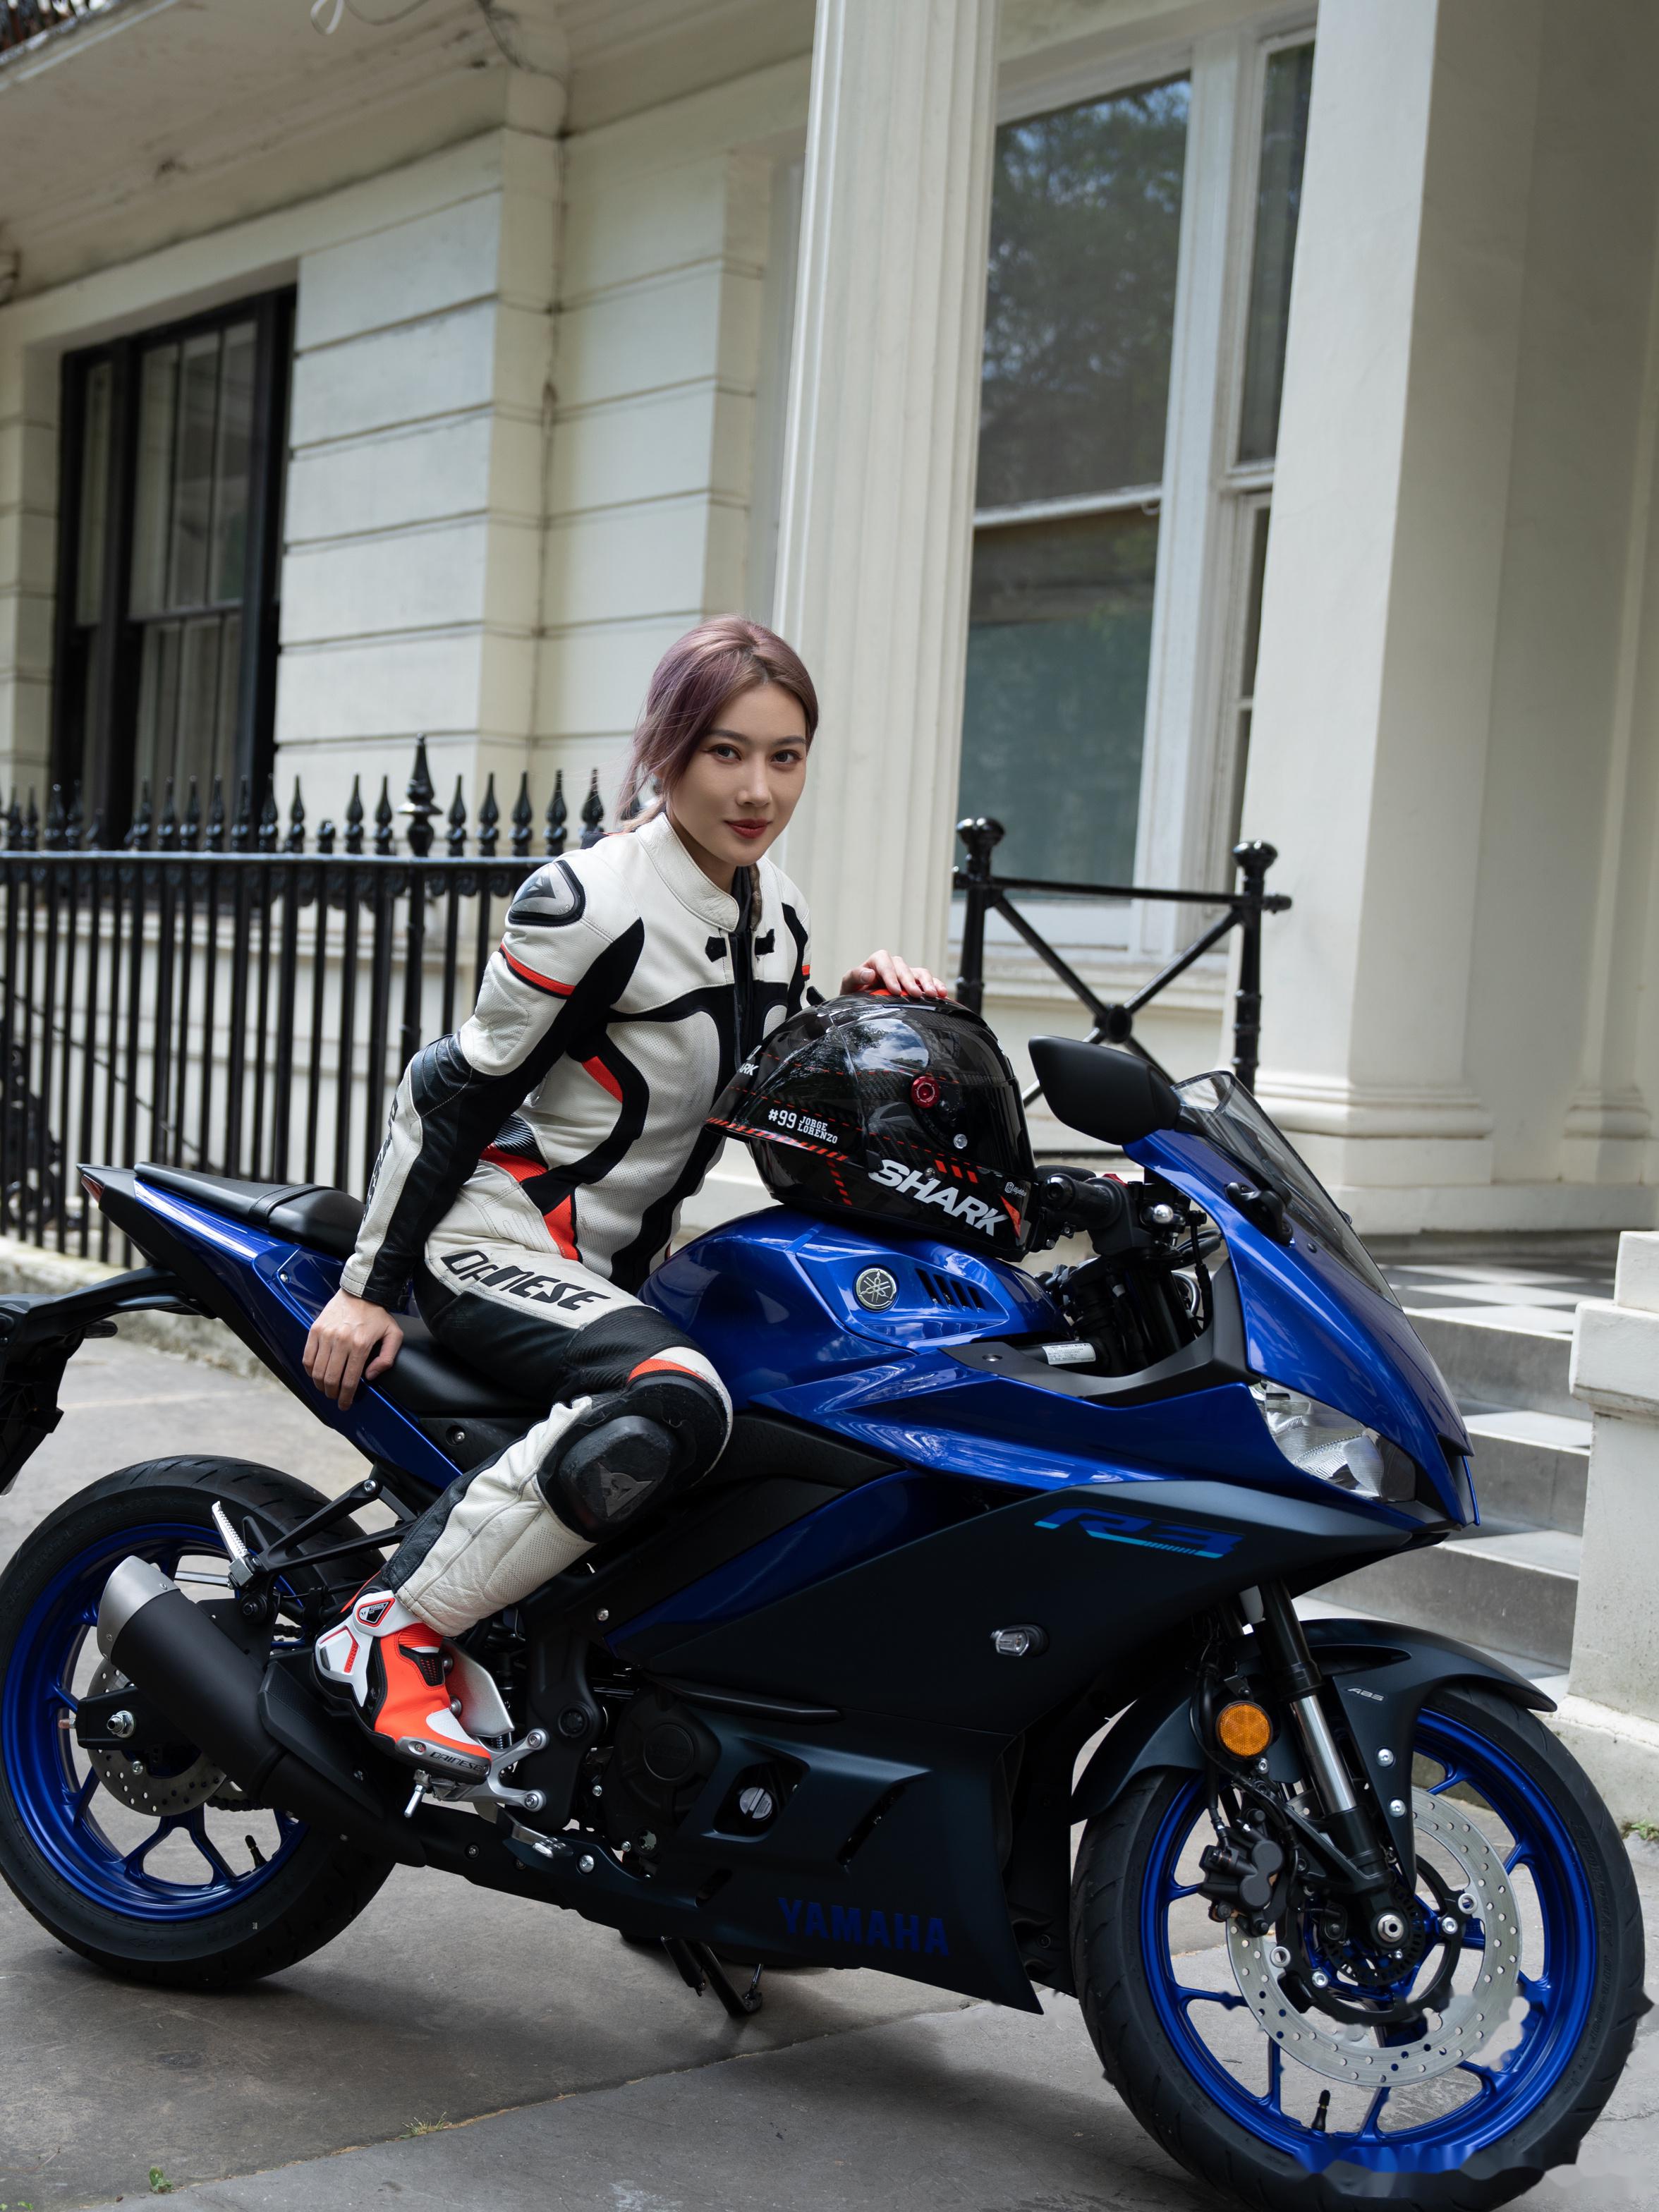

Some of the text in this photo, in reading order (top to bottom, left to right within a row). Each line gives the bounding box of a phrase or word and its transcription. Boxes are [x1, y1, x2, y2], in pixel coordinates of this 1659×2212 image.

[768, 1109, 797, 1129] #99
[800, 1116, 828, 1131] JORGE
[797, 1123, 838, 1143] LORENZO
[868, 1159, 1009, 1236] SHARK
[1034, 1507, 1244, 1558] R3
[1347, 1688, 1384, 1701] ABS
[429, 1751, 482, 1771] DAINESE
[777, 1896, 949, 1957] YAMAHA
